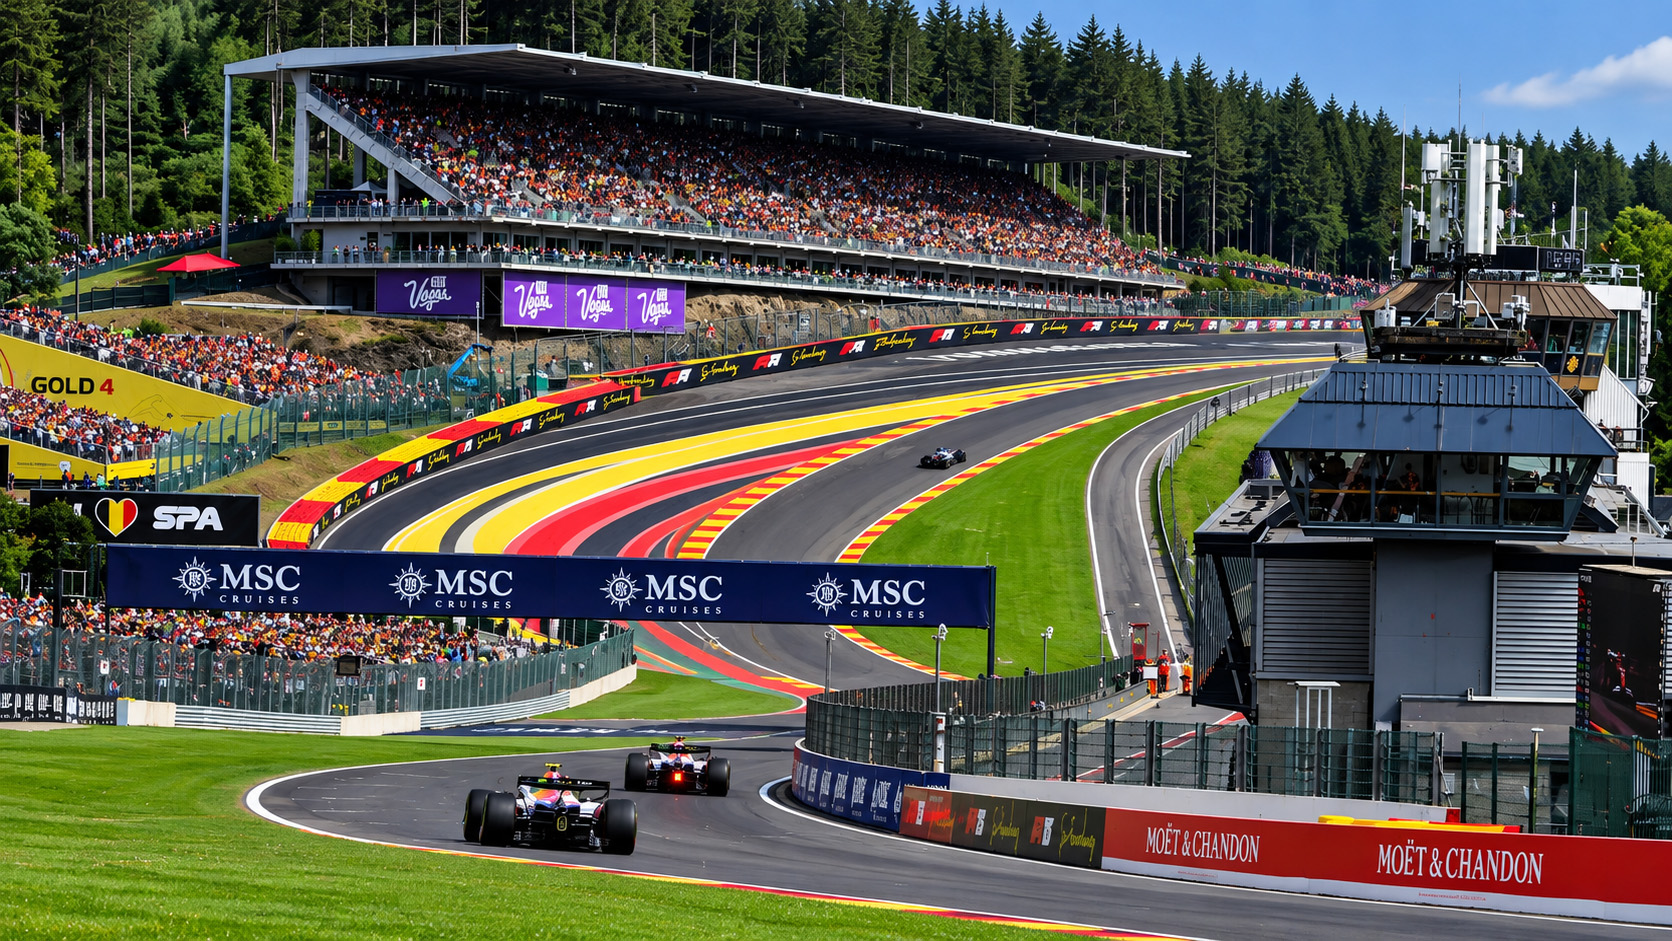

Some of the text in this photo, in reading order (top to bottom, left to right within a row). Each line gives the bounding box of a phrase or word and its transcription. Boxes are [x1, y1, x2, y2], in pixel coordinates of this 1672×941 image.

[31, 376, 115, 395] GOLD 4
[152, 505, 224, 531] SPA
[219, 564, 300, 591] MSC
[435, 569, 513, 597] MSC
[645, 574, 723, 602] MSC
[219, 595, 299, 604] CRUISES
[435, 600, 512, 609] CRUISES
[851, 578, 926, 606] MSC
[645, 605, 722, 614] CRUISES
[850, 610, 925, 619] CRUISES
[1145, 822, 1260, 863] MOËT & CHANDON
[1377, 839, 1544, 885] MOËT & CHANDON
